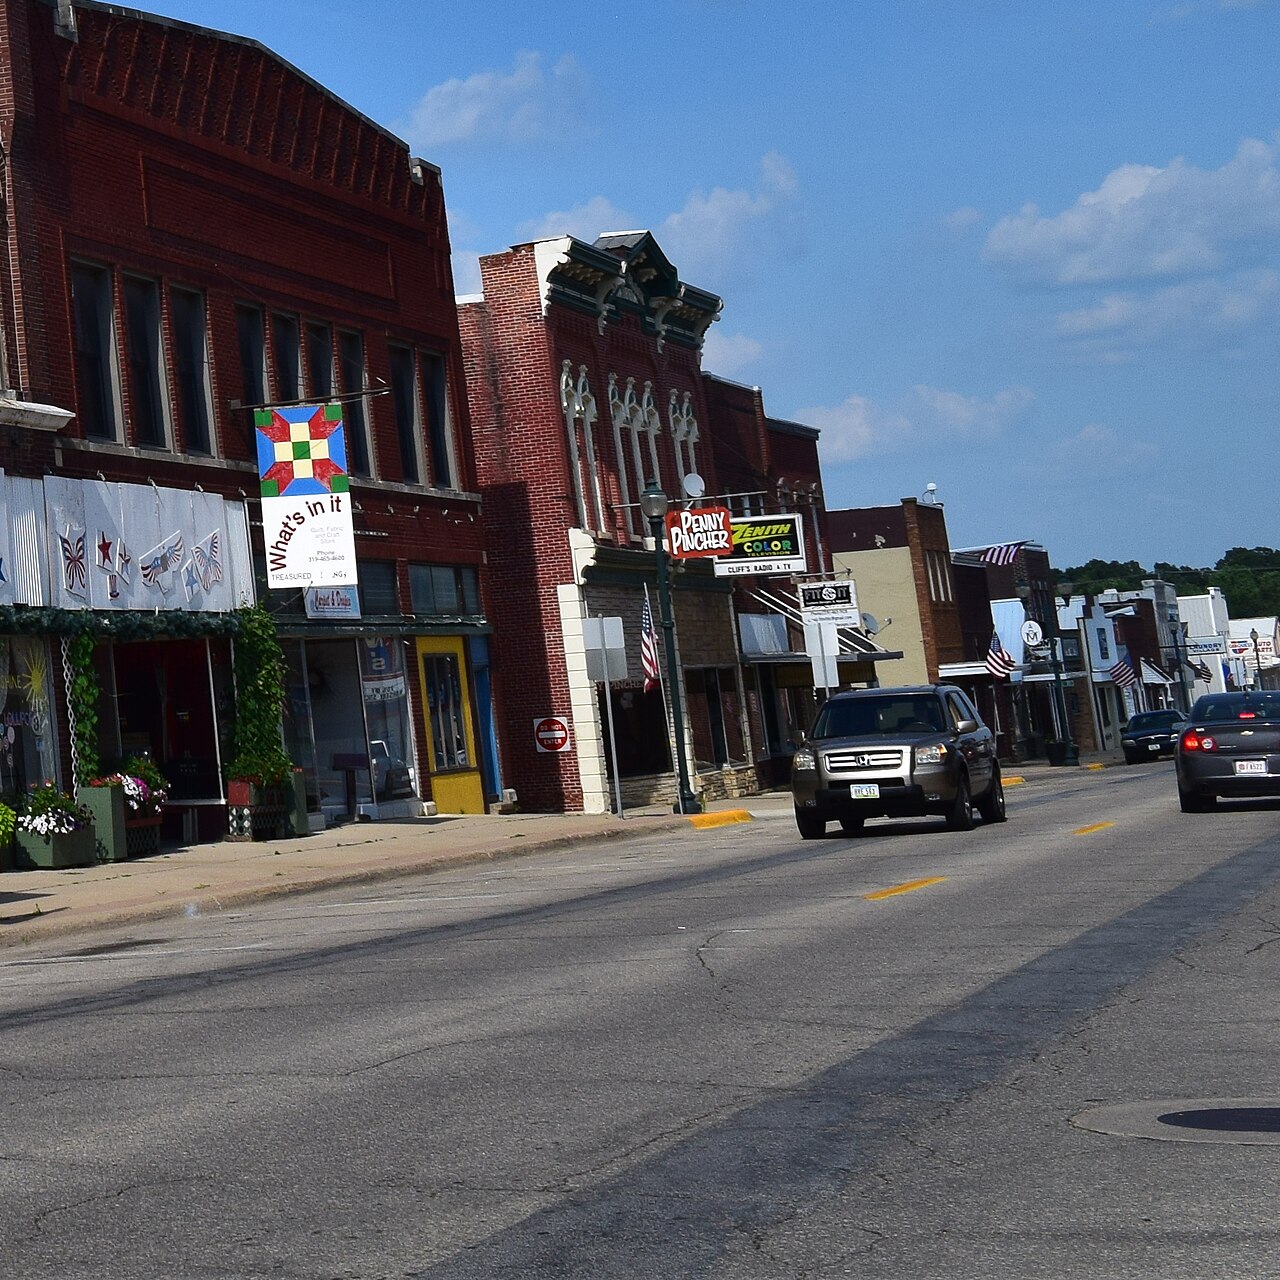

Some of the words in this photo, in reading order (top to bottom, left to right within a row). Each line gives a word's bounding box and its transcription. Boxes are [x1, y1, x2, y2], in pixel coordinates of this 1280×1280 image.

[269, 512, 306, 572] What's
[305, 500, 325, 517] in
[330, 494, 342, 513] it
[680, 511, 725, 535] PENNY
[731, 523, 791, 544] ZENITH
[670, 527, 730, 555] PINCHER
[743, 540, 792, 552] COLOR
[271, 572, 312, 581] TREASURED
[728, 565, 751, 573] CLIFF'S
